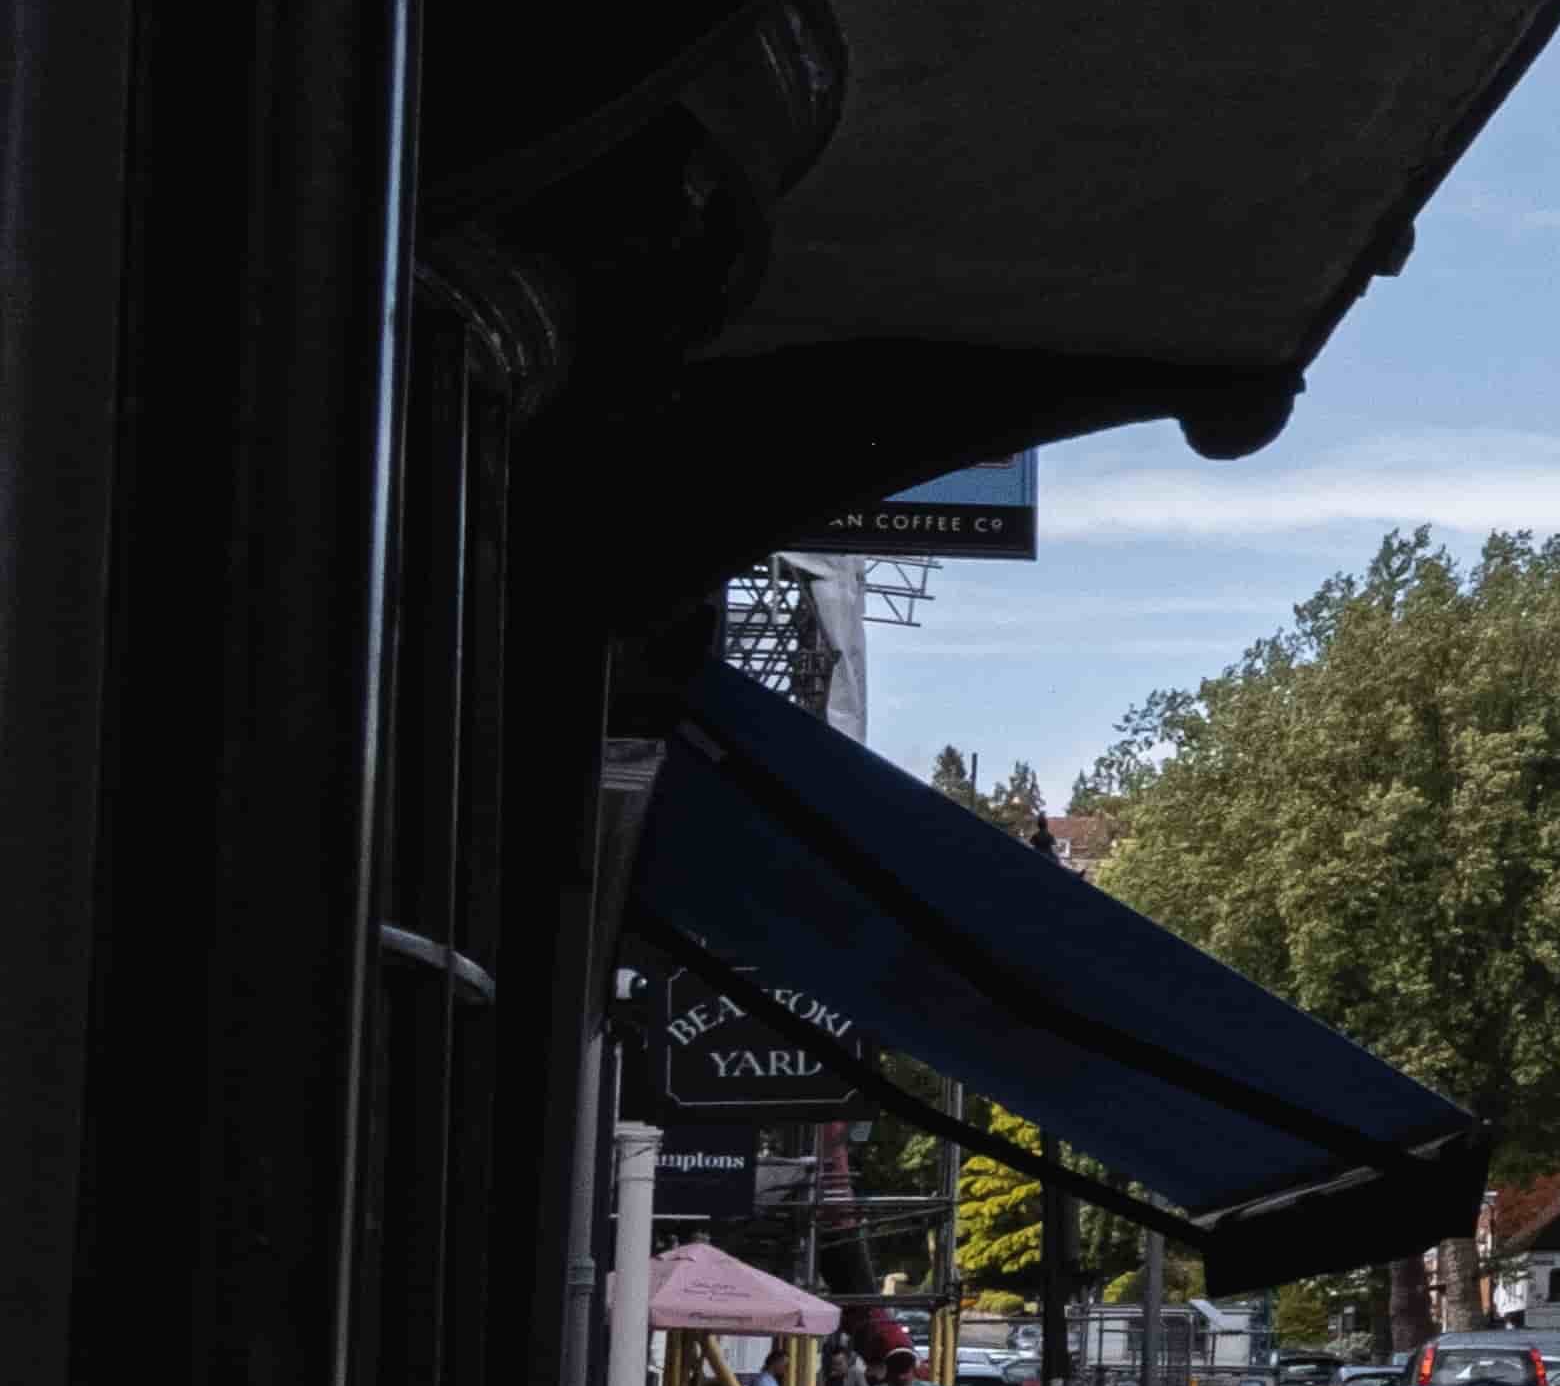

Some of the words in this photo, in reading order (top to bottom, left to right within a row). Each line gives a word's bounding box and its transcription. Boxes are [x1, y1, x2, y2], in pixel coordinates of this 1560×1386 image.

[876, 514, 961, 531] COFFEE
[709, 1050, 822, 1077] YARD
[656, 1153, 745, 1172] mptons
